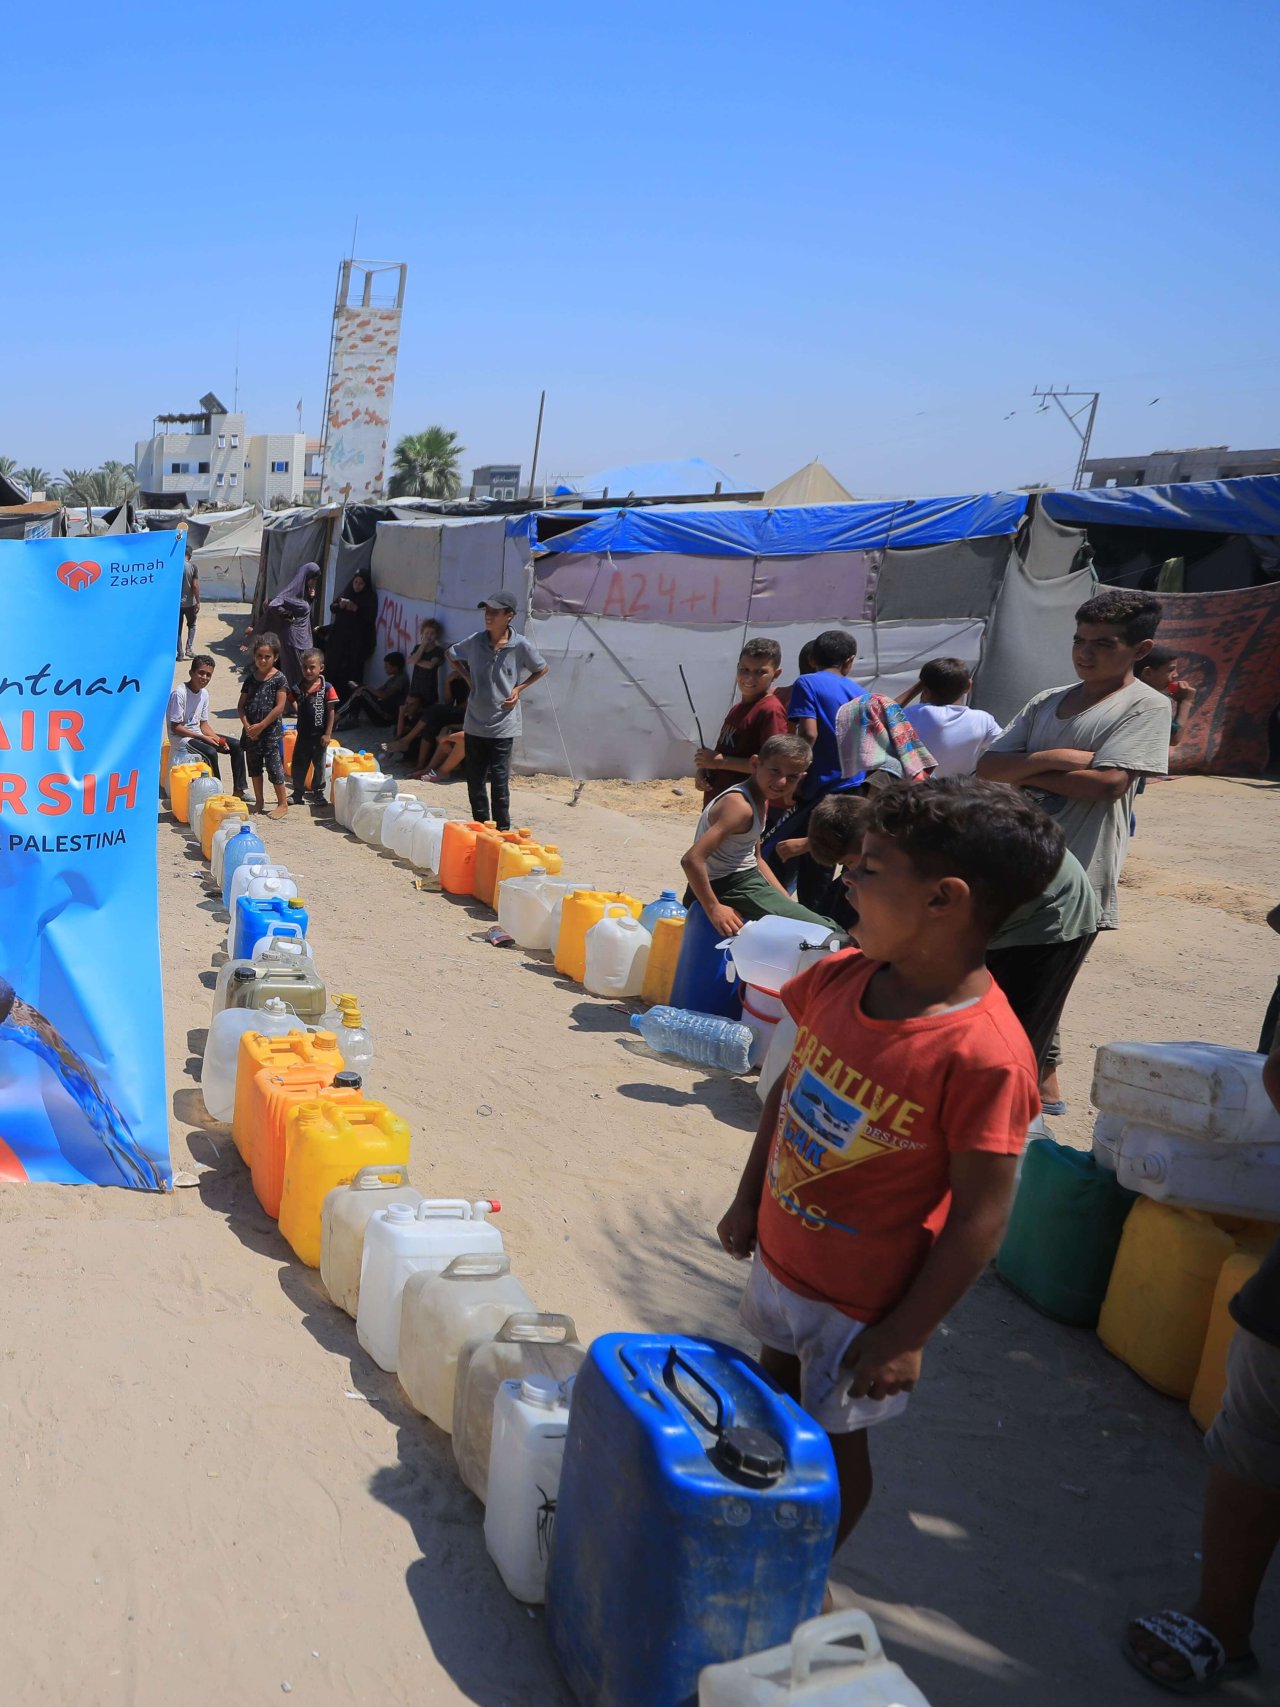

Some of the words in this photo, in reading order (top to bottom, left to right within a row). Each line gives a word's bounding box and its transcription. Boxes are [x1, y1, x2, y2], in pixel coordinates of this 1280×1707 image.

[110, 558, 165, 573] Rumah
[110, 573, 155, 587] Zakat
[602, 571, 720, 621] A24+1
[9, 828, 127, 853] PALESTINA
[792, 1025, 926, 1137] CREATIVE
